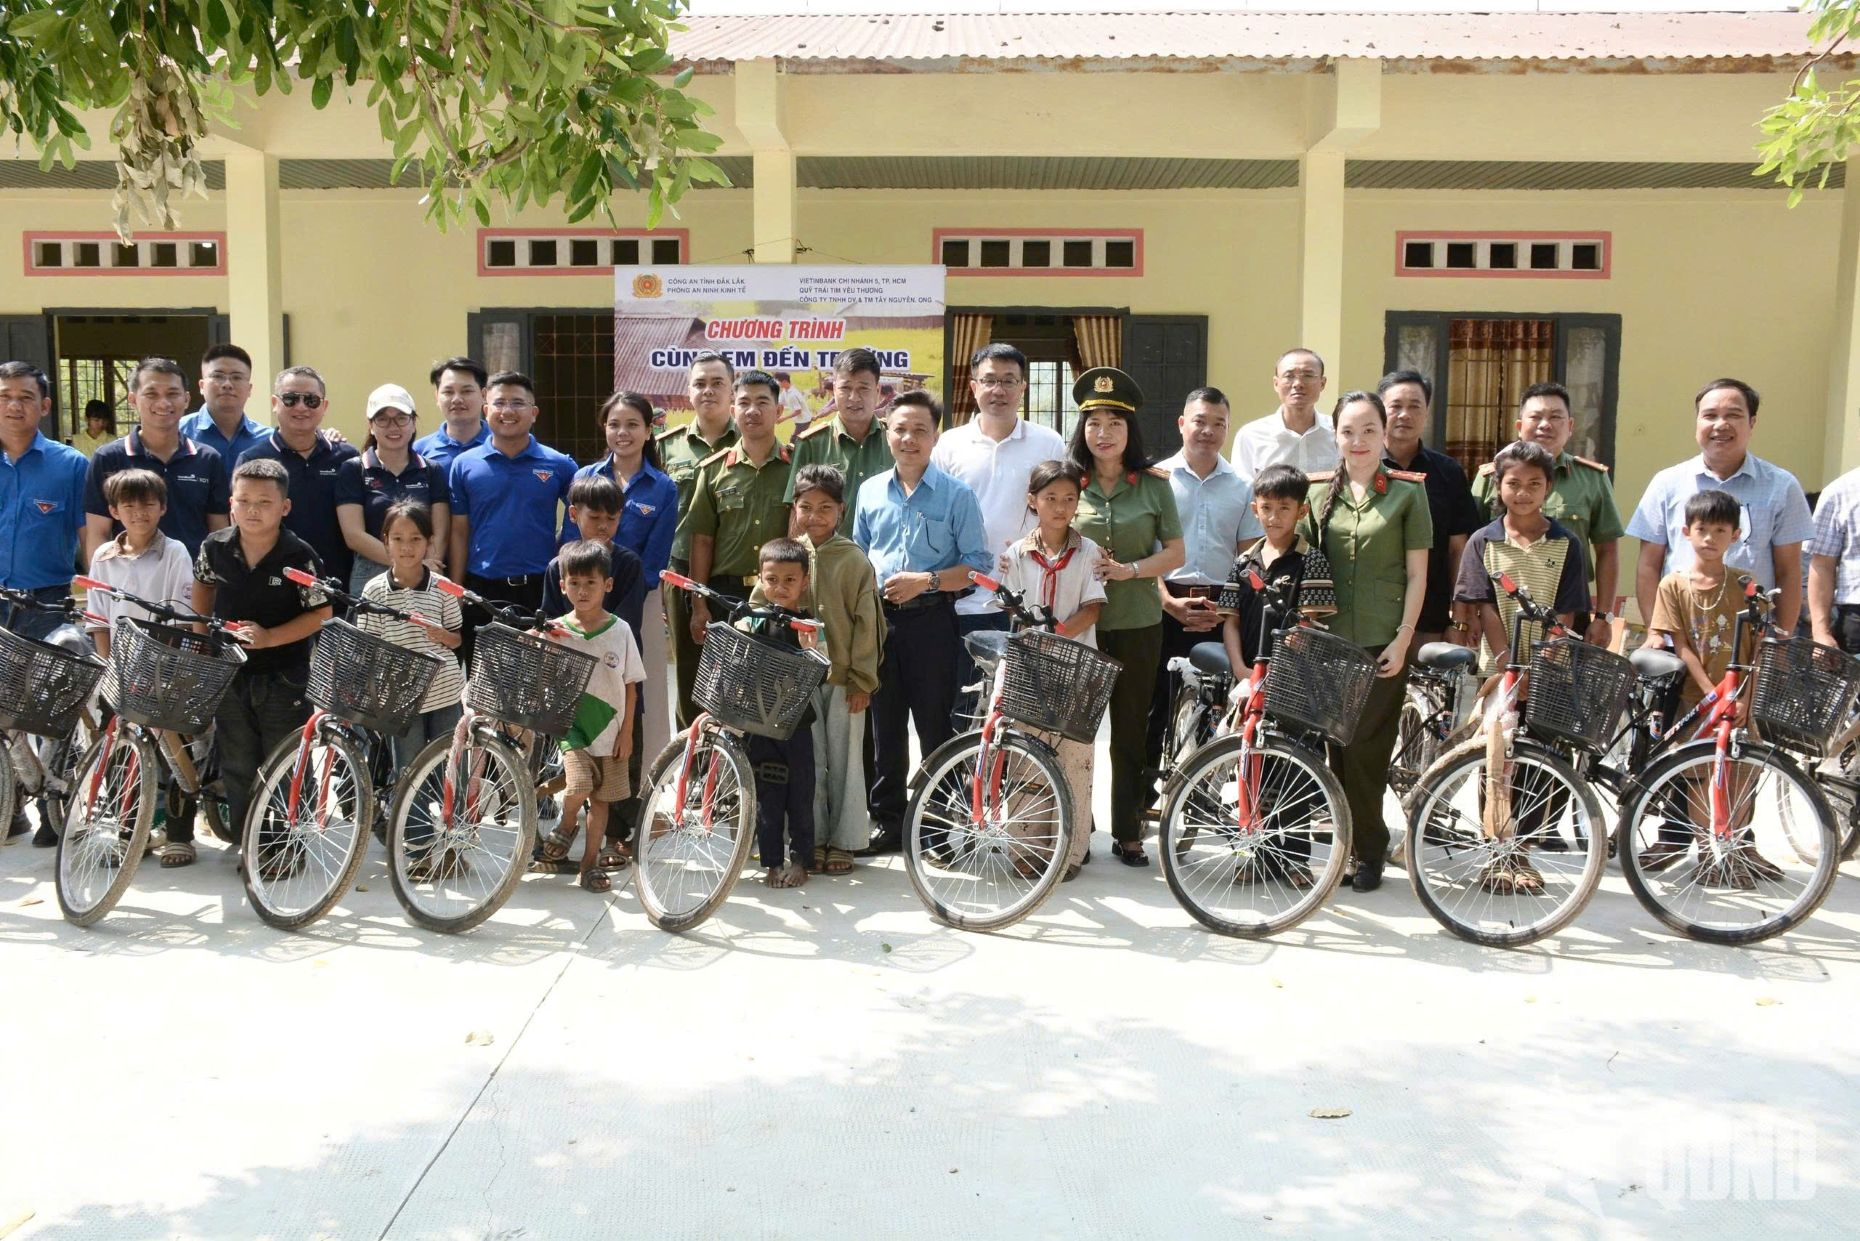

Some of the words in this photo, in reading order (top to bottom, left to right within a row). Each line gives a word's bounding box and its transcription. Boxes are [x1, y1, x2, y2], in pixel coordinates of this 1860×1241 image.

[707, 319, 783, 338] CHƯƠNG
[789, 317, 844, 339] TRÌNH
[651, 348, 711, 367] CÙN
[763, 346, 809, 367] ĐẾN
[816, 348, 908, 368] TNG
